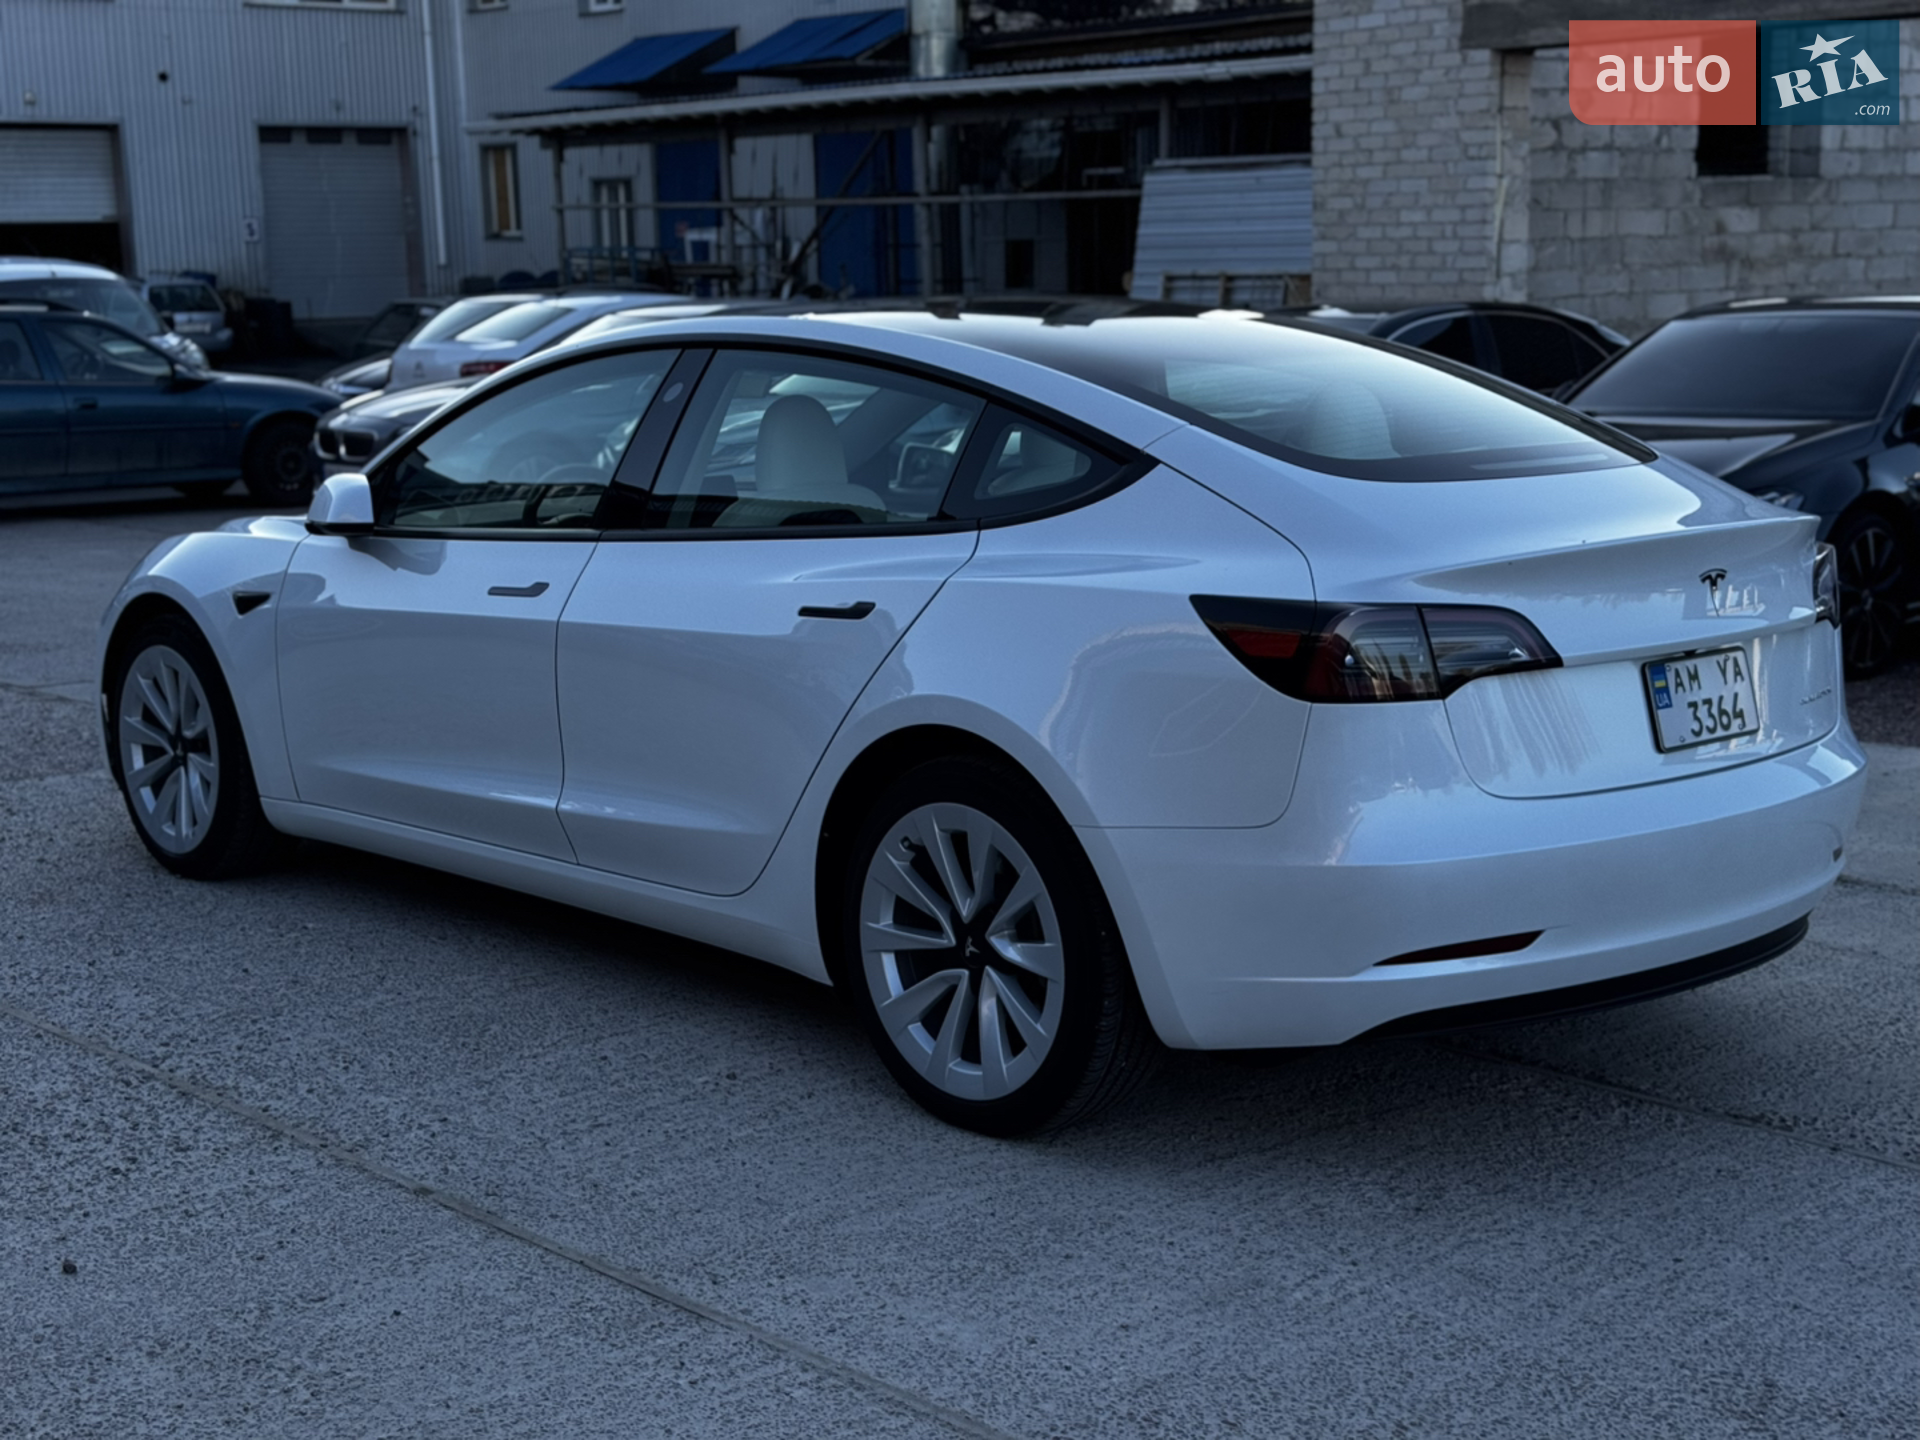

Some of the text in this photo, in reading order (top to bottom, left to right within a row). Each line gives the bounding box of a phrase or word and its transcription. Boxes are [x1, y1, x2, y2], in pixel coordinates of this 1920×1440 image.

[1674, 656, 1744, 694] AM YA
[1687, 692, 1746, 737] 3364
